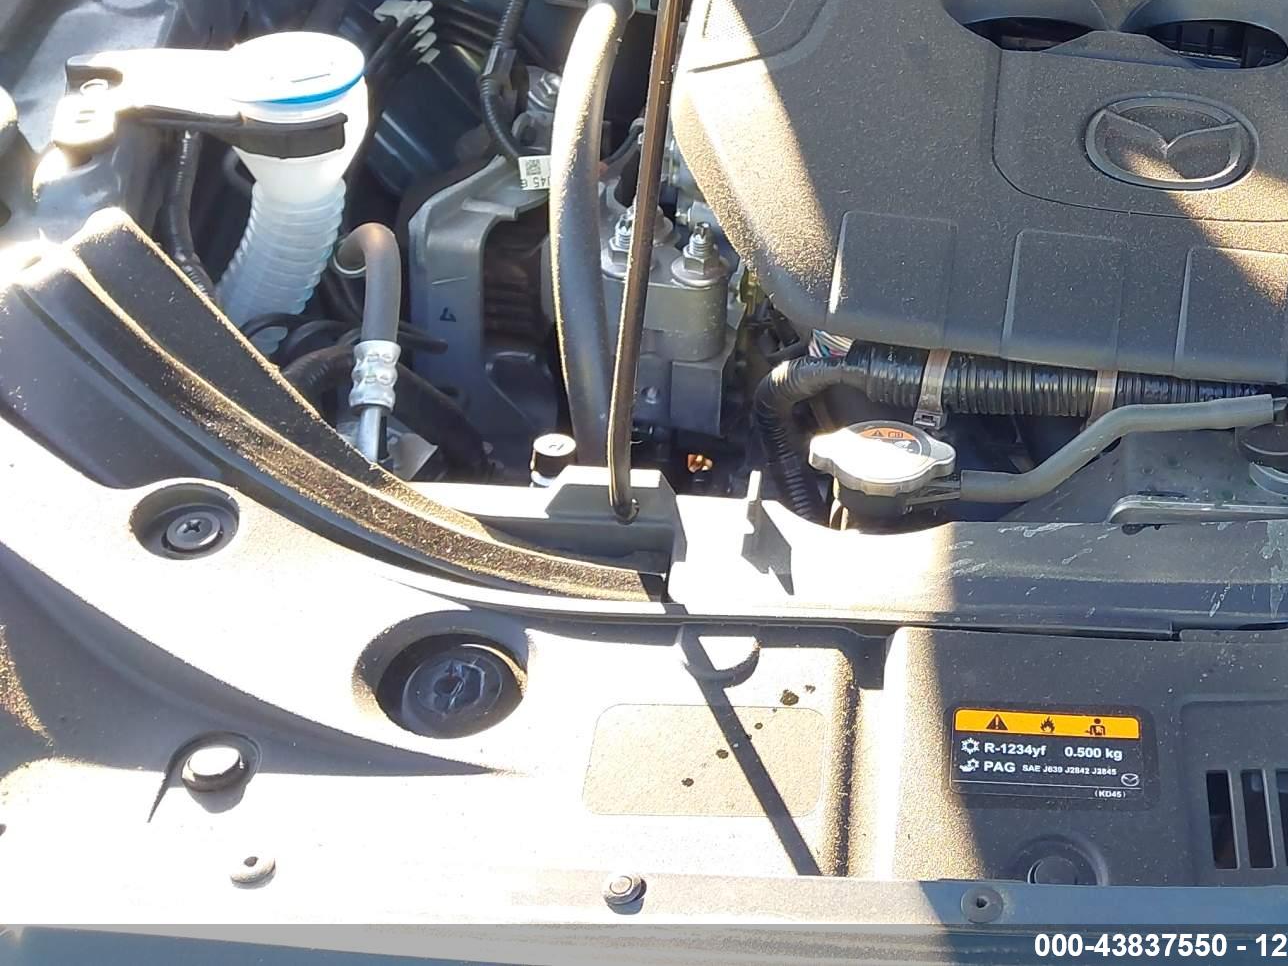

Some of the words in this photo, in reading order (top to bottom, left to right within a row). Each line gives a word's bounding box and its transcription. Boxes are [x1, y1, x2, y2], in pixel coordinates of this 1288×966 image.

[984, 742, 1047, 757] R-1234yf
[1064, 746, 1102, 758] 0.500
[1105, 746, 1123, 761] kg
[983, 762, 1016, 773] PAG
[1022, 764, 1041, 772] SAE
[1042, 764, 1063, 774] J639
[1064, 766, 1090, 775] J2842
[1091, 766, 1118, 776] J2845
